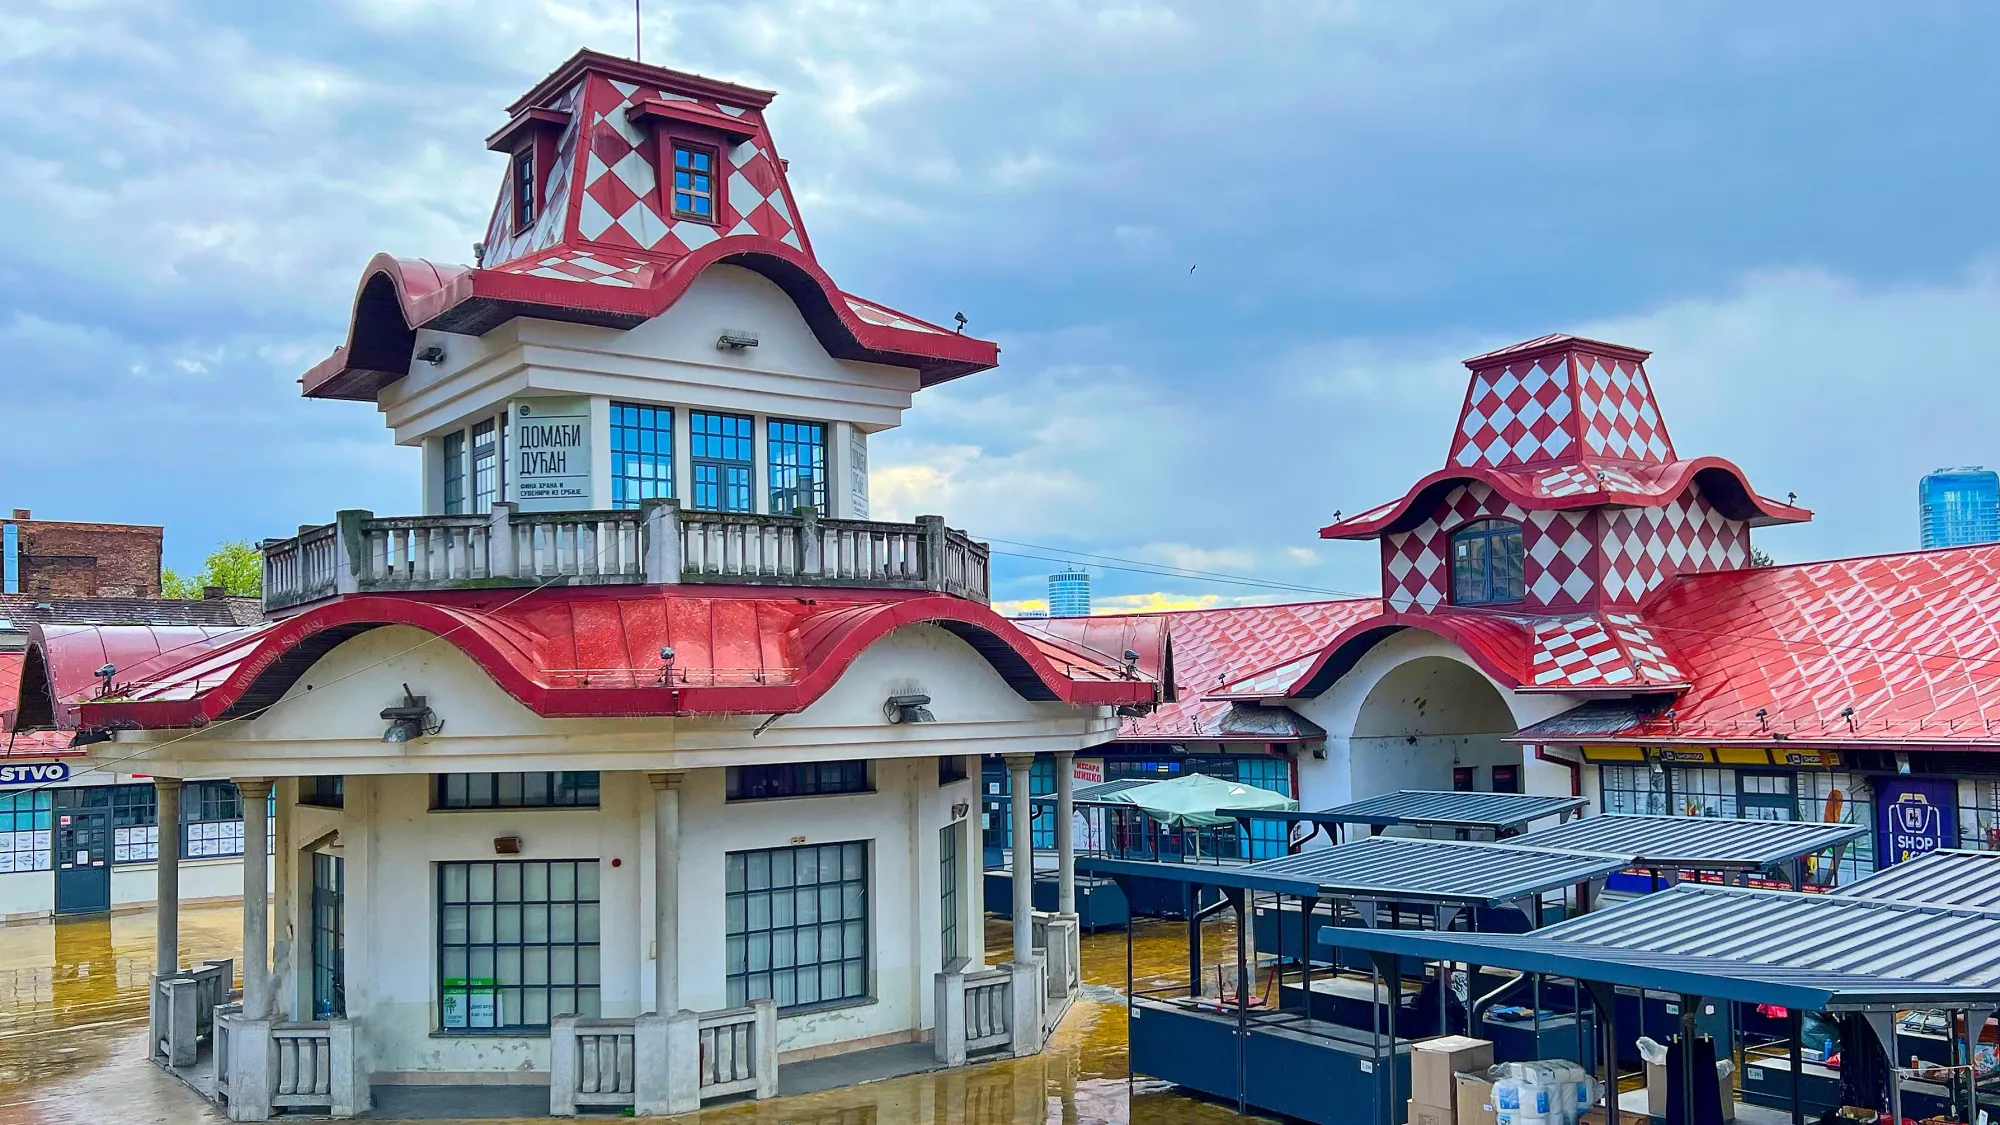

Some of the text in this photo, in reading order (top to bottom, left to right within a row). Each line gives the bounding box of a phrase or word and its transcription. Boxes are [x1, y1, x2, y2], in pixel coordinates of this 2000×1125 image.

[519, 424, 581, 449] ДОМАЋИ
[519, 450, 566, 476] ДУЋАН
[0, 765, 64, 782] STVO
[1897, 835, 1934, 850] SHOP
